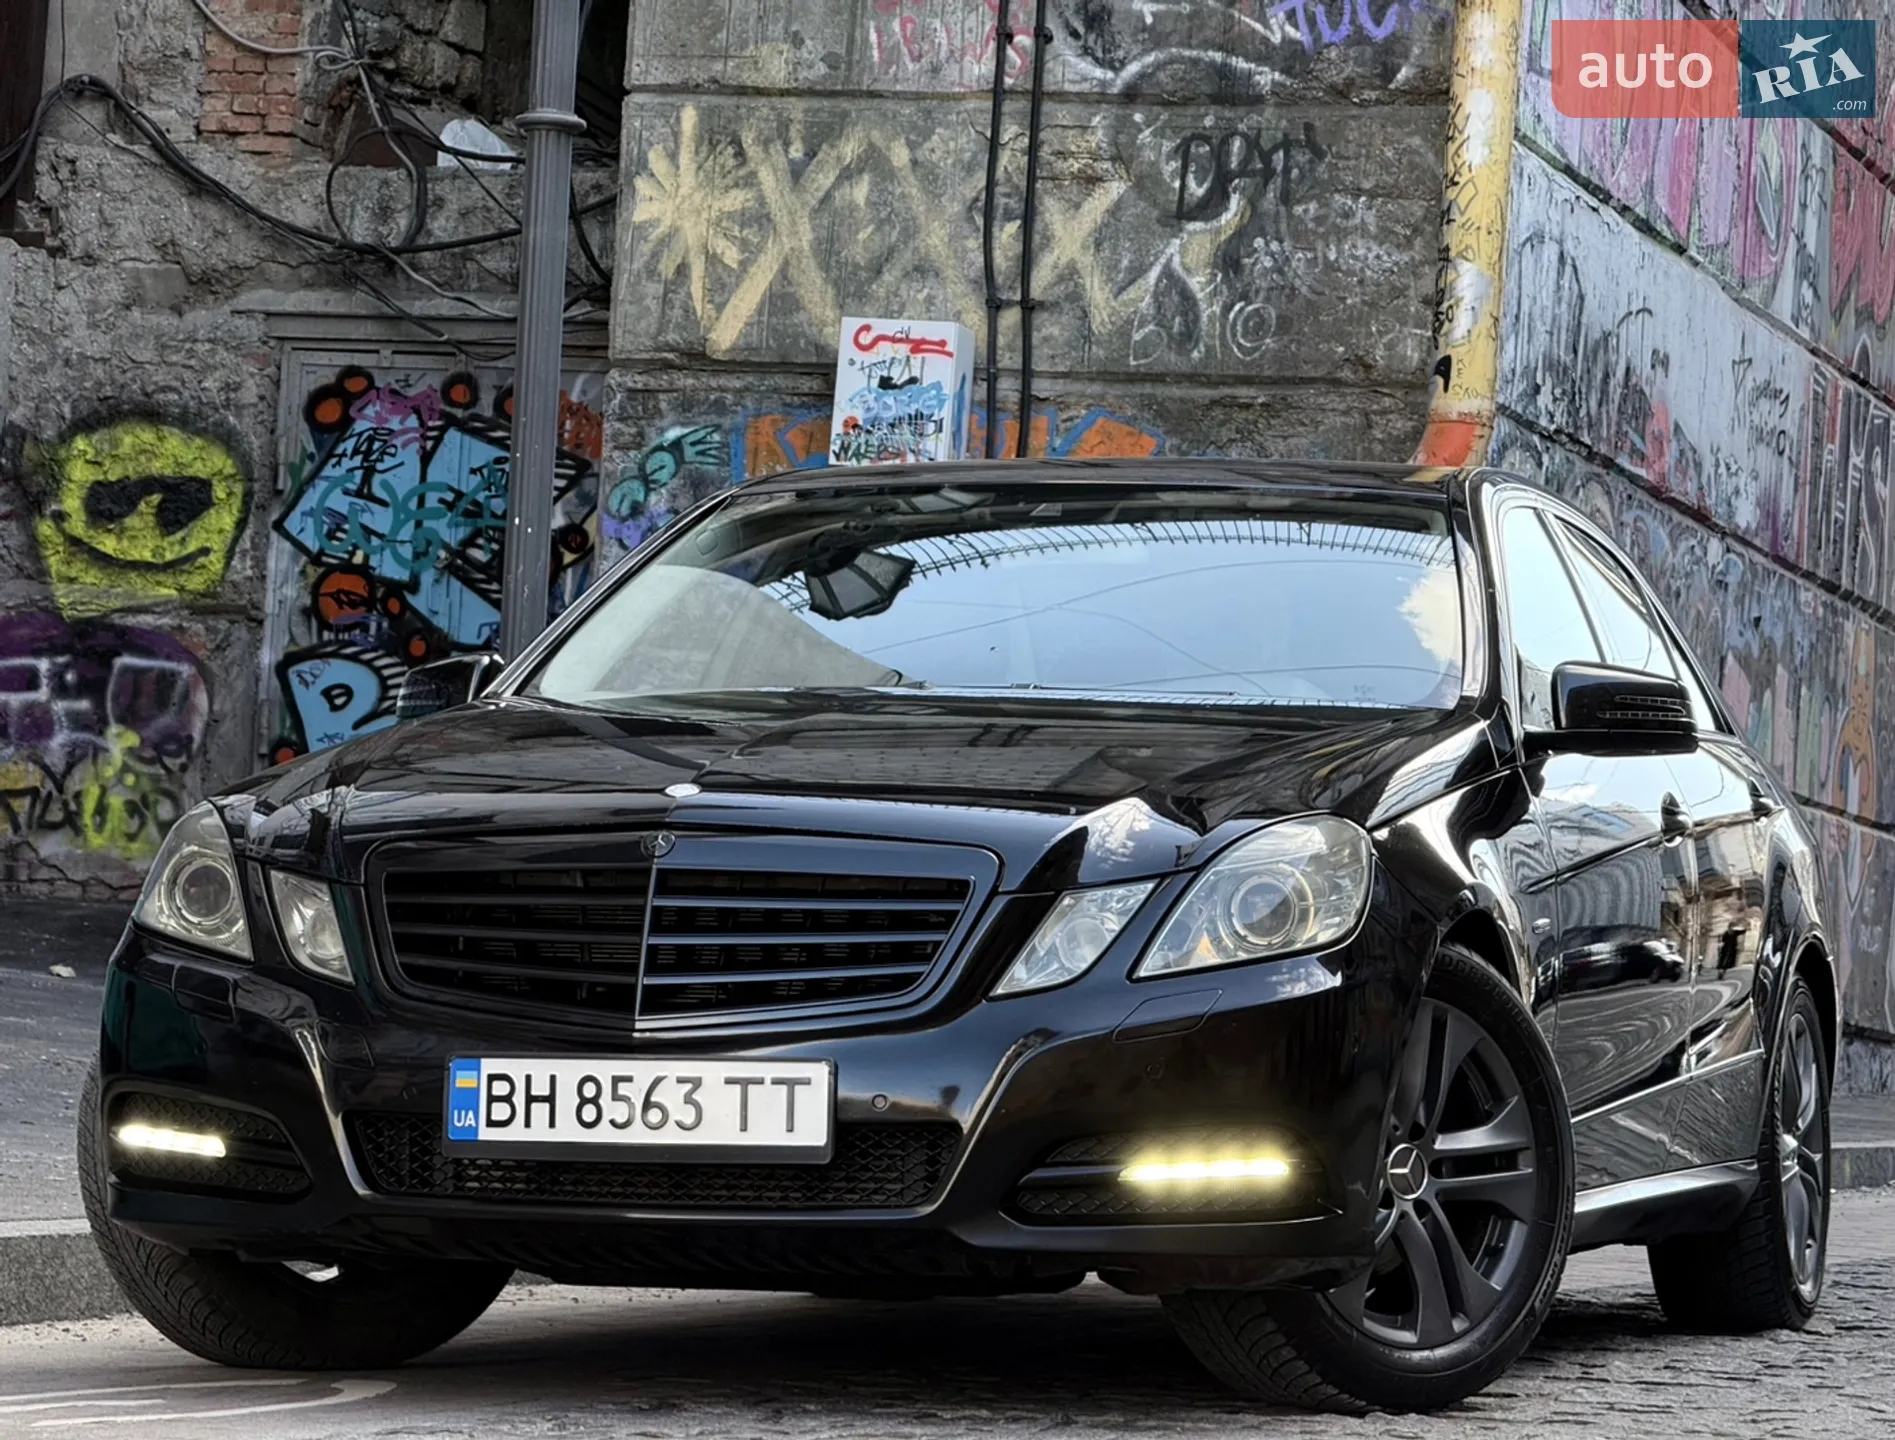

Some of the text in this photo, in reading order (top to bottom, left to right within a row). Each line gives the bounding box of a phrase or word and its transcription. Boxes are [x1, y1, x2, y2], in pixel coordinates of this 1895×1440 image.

[453, 1109, 476, 1127] UA
[485, 1073, 812, 1133] BH 8563 TT
